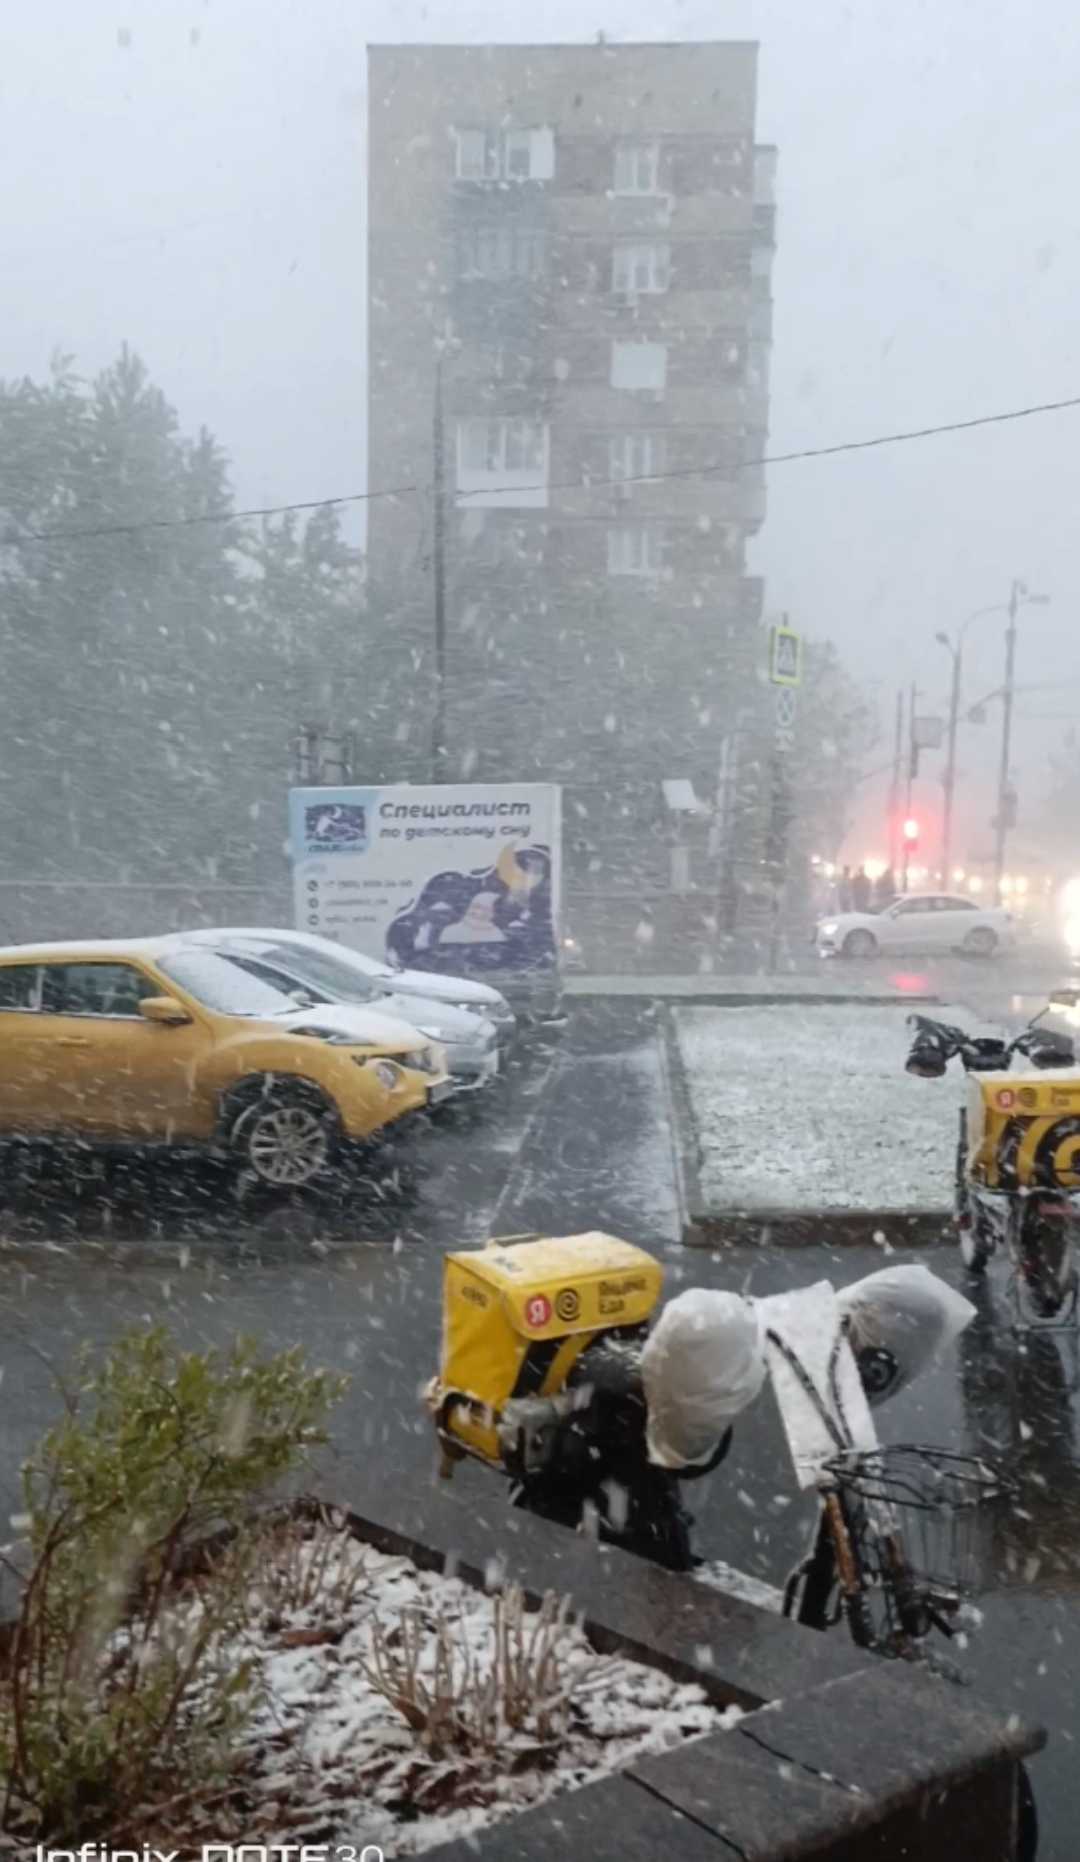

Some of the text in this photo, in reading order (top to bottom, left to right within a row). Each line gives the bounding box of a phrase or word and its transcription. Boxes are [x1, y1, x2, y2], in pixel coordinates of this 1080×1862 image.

[379, 802, 531, 820] Специалист
[380, 825, 531, 841] по детскому сну
